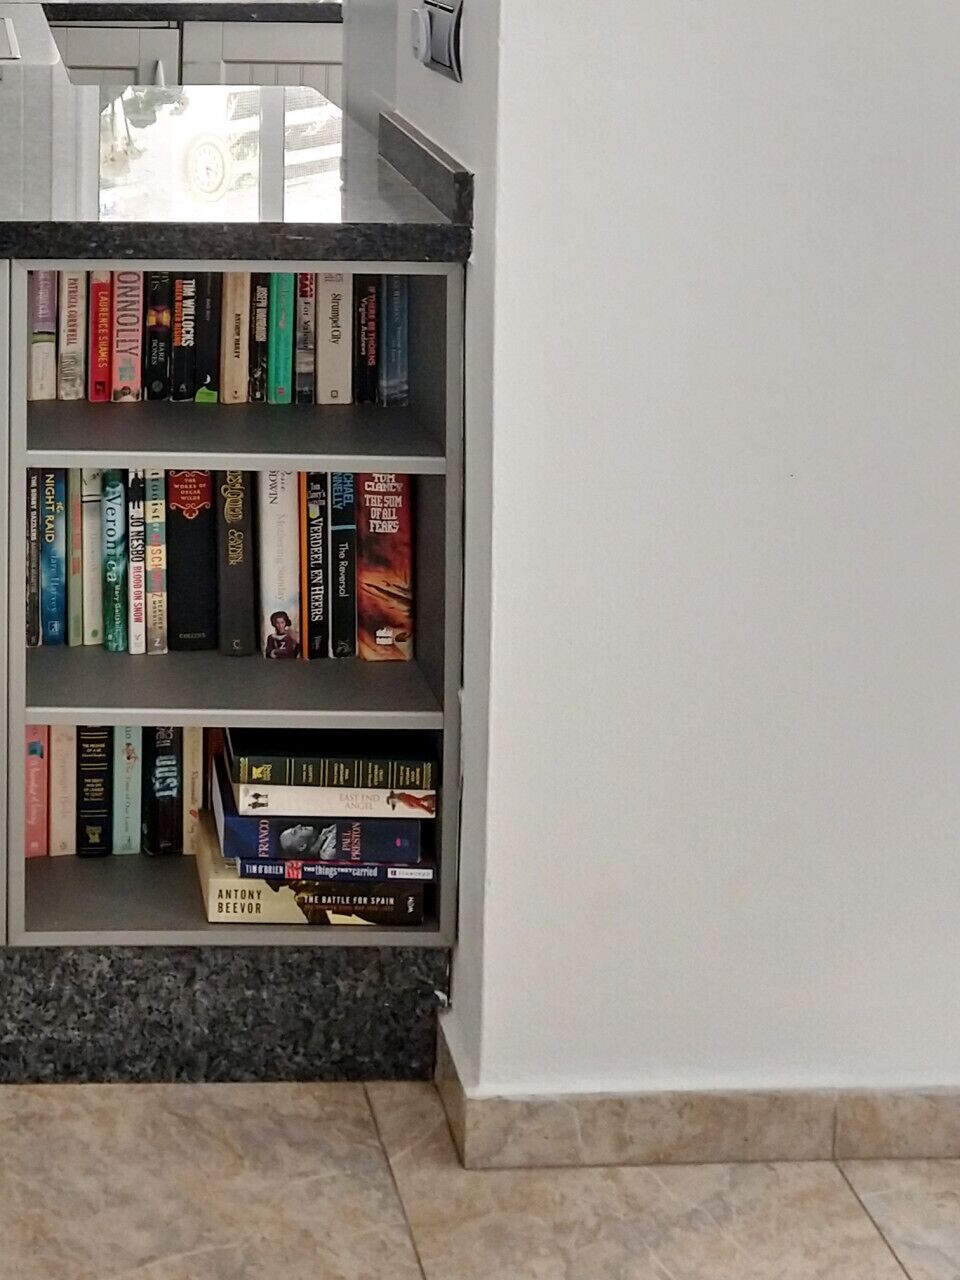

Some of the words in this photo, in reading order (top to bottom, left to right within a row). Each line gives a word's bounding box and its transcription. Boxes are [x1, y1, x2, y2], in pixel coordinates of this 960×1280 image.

[67, 277, 78, 308] PATRICIA
[181, 278, 196, 297] TIM
[255, 285, 268, 308] JOSEPH
[98, 291, 109, 333] LAURENCE
[116, 271, 141, 357] ONNOLLY
[181, 298, 196, 347] WILLOCKS
[303, 301, 311, 316] For
[328, 292, 342, 328] Strumpet
[358, 297, 368, 325] Virginia
[66, 310, 78, 346] CORNWELL
[328, 329, 342, 345] City
[360, 325, 368, 356] Andrews
[97, 336, 108, 369] SHAMES
[151, 339, 159, 365] BONES
[157, 342, 166, 363] BARE
[367, 332, 376, 366] THORNS
[268, 471, 279, 505] DWIN
[332, 472, 343, 511] NNELLY
[342, 472, 354, 507] CHAEL
[364, 481, 404, 492] CLANCY
[372, 473, 396, 483] TOM
[44, 474, 55, 511] NIGHT
[150, 471, 163, 521] ttooist
[363, 494, 383, 507] THE
[383, 495, 403, 508] SUM
[130, 514, 144, 528] JO
[368, 519, 401, 534] FEARS
[370, 507, 382, 520] OF
[382, 507, 398, 520] ALL
[44, 515, 55, 544] RAID
[105, 494, 122, 583] Veronica
[310, 517, 324, 568] VERDEEL
[130, 530, 145, 563] NESBO
[338, 541, 349, 559] The
[132, 565, 142, 589] BLOOD
[310, 569, 322, 585] EN
[338, 560, 350, 598] Reversal
[112, 584, 121, 602] Mary
[133, 590, 142, 601] ON
[310, 586, 325, 623] HEERS
[132, 602, 142, 624] SNOW
[155, 754, 178, 798] DUST
[257, 818, 271, 858] FRANCO
[342, 831, 352, 852] PAUL
[351, 821, 362, 861] PRESTON
[245, 864, 257, 874] TIM
[258, 865, 284, 875] O'BRIEN
[352, 867, 378, 878] carried
[217, 889, 263, 901] ANTONY
[217, 902, 262, 914] BEEVOR
[304, 895, 319, 905] THE
[321, 895, 351, 905] BATTLE
[353, 896, 369, 905] FOR
[370, 896, 396, 906] SPAIN
